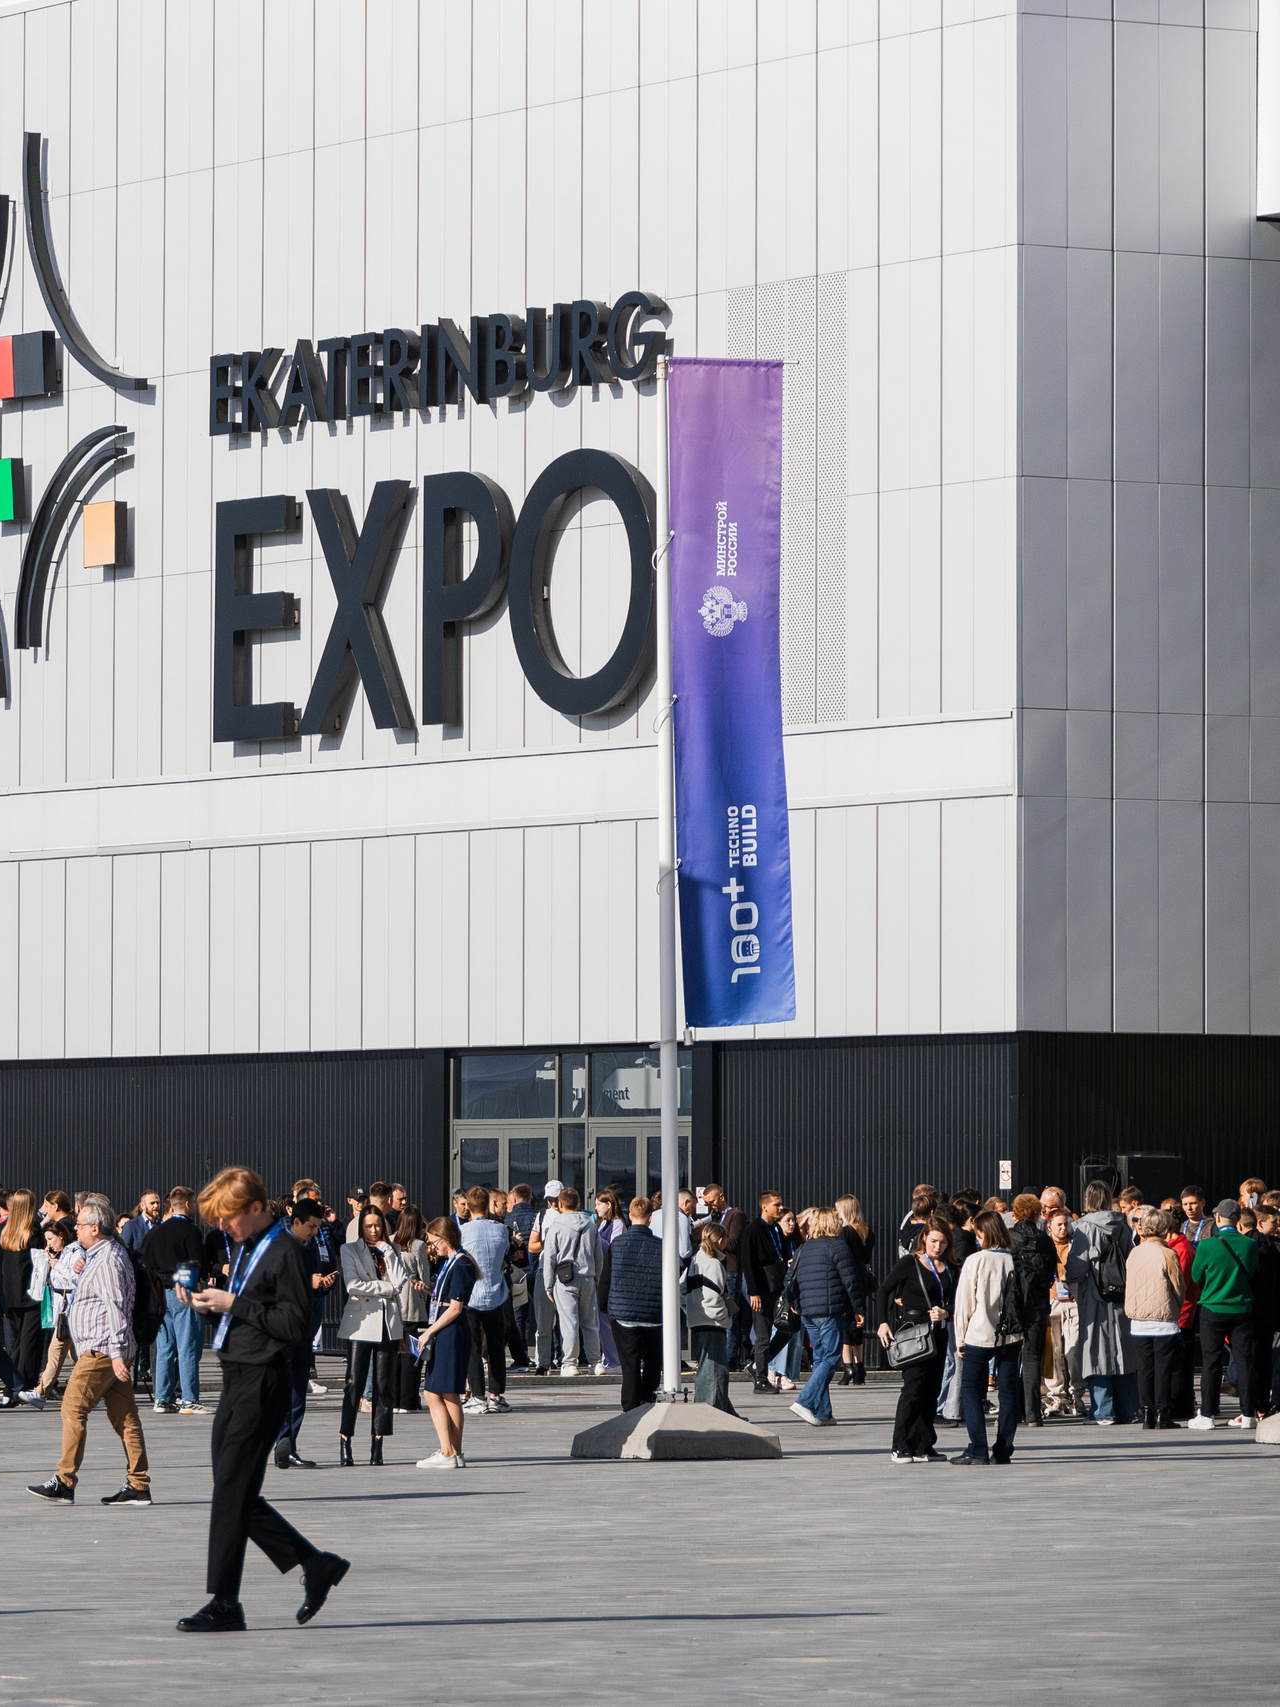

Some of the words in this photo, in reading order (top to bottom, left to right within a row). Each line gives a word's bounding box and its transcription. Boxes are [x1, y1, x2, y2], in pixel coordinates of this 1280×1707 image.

[209, 291, 668, 437] EKATERINBURG
[715, 501, 727, 576] МИНСТРОЙ
[727, 522, 738, 576] РОССИИ
[213, 448, 658, 743] EXPO
[727, 805, 740, 868] TECHNO
[741, 804, 758, 867] BUILD
